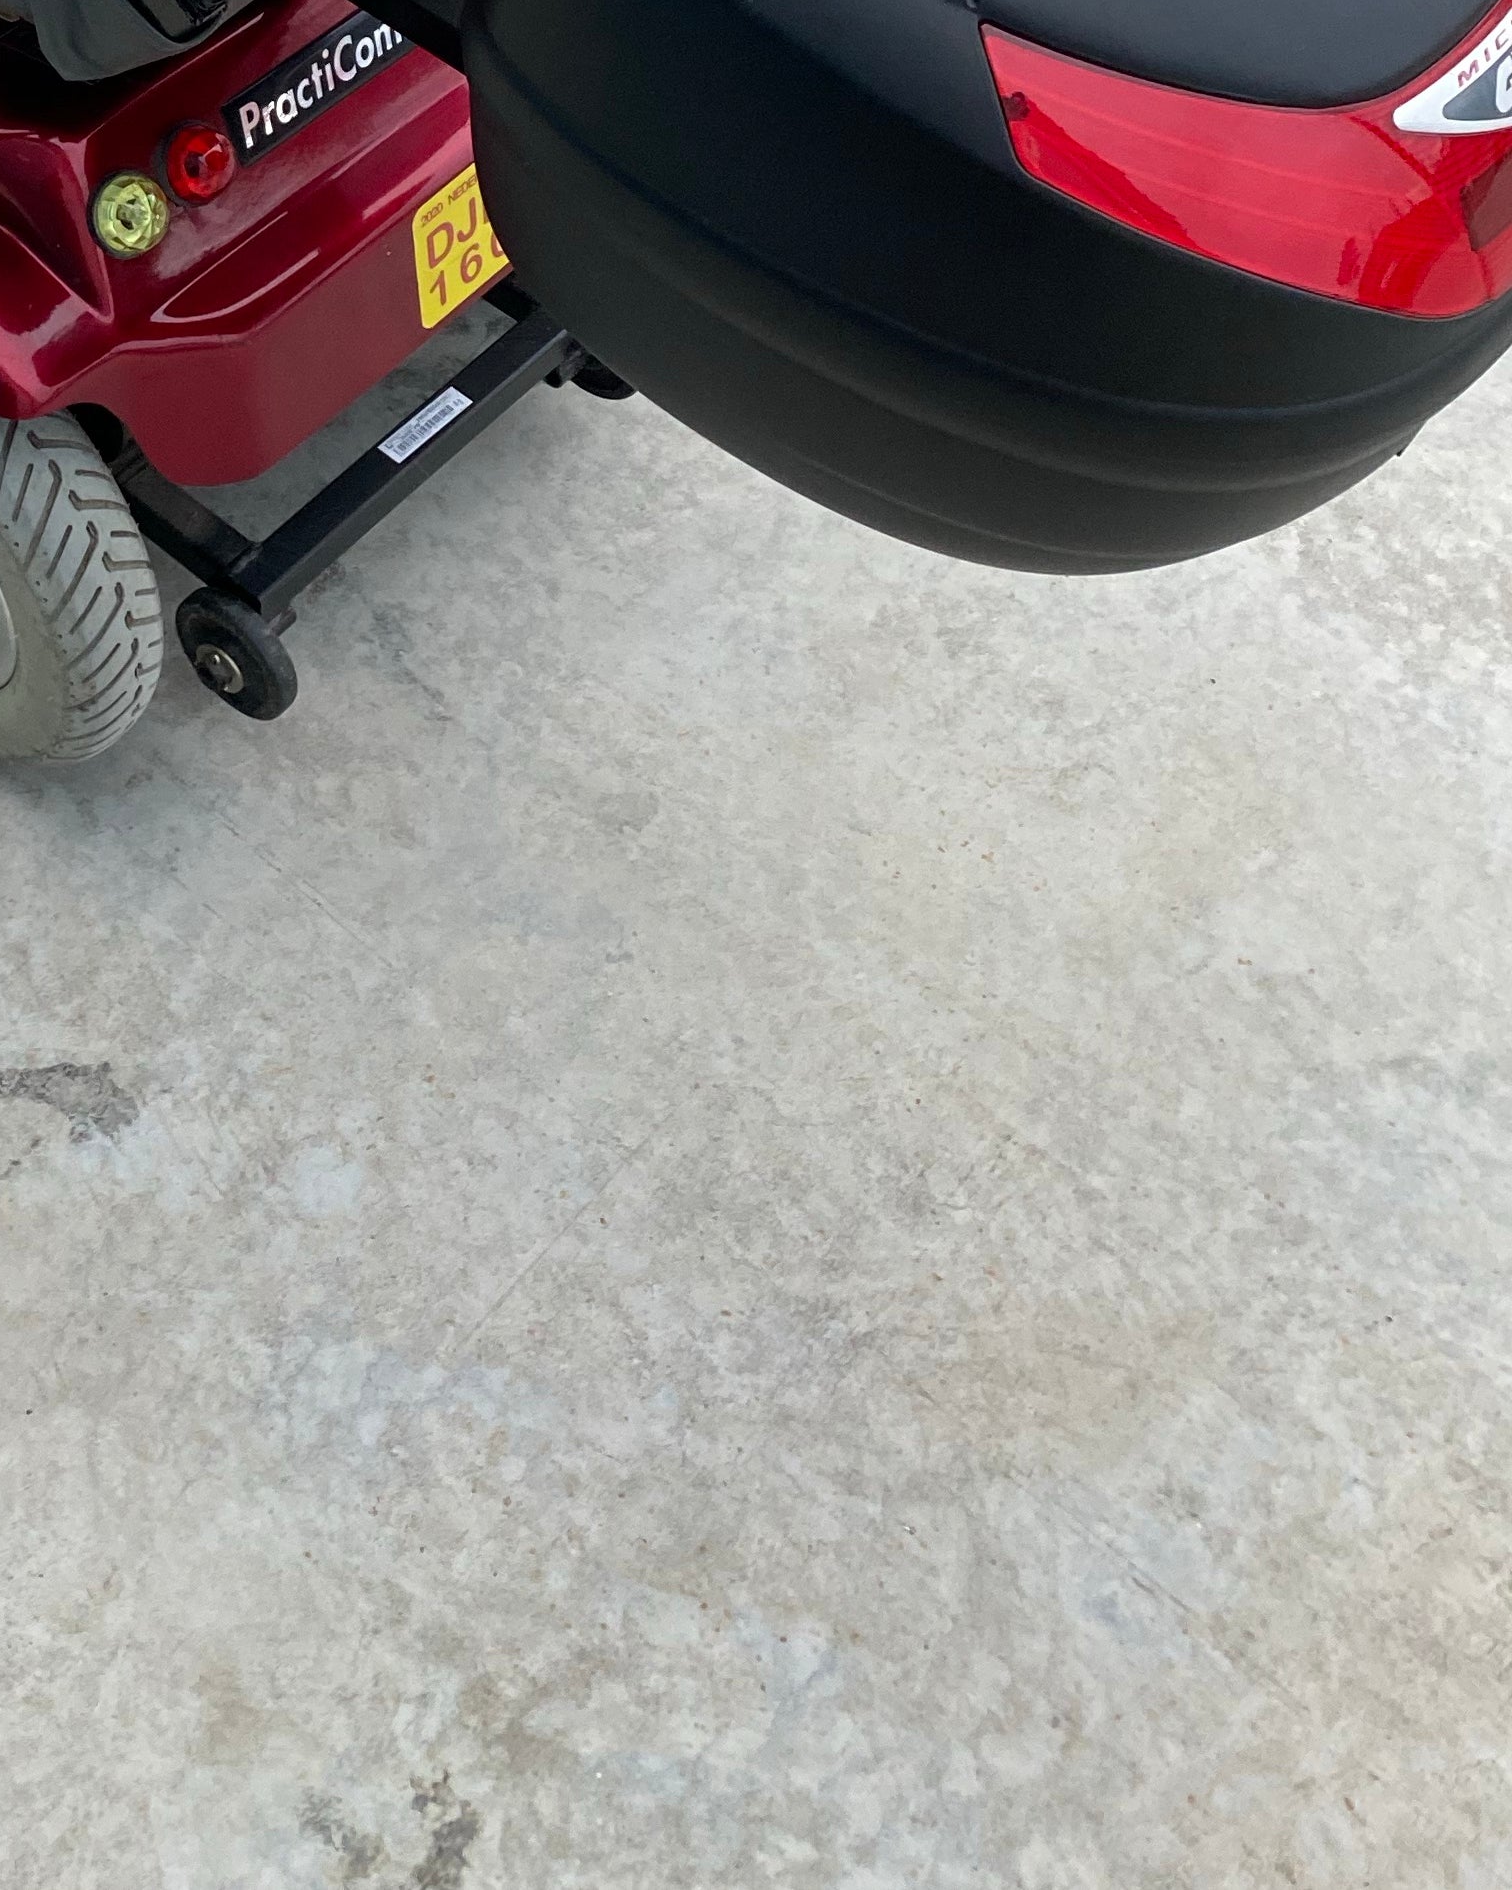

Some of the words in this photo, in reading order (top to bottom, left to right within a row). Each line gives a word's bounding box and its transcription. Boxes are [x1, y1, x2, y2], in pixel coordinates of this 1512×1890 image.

[238, 22, 404, 149] PractiCom
[1457, 19, 1512, 87] MIC
[426, 196, 490, 270] DJ
